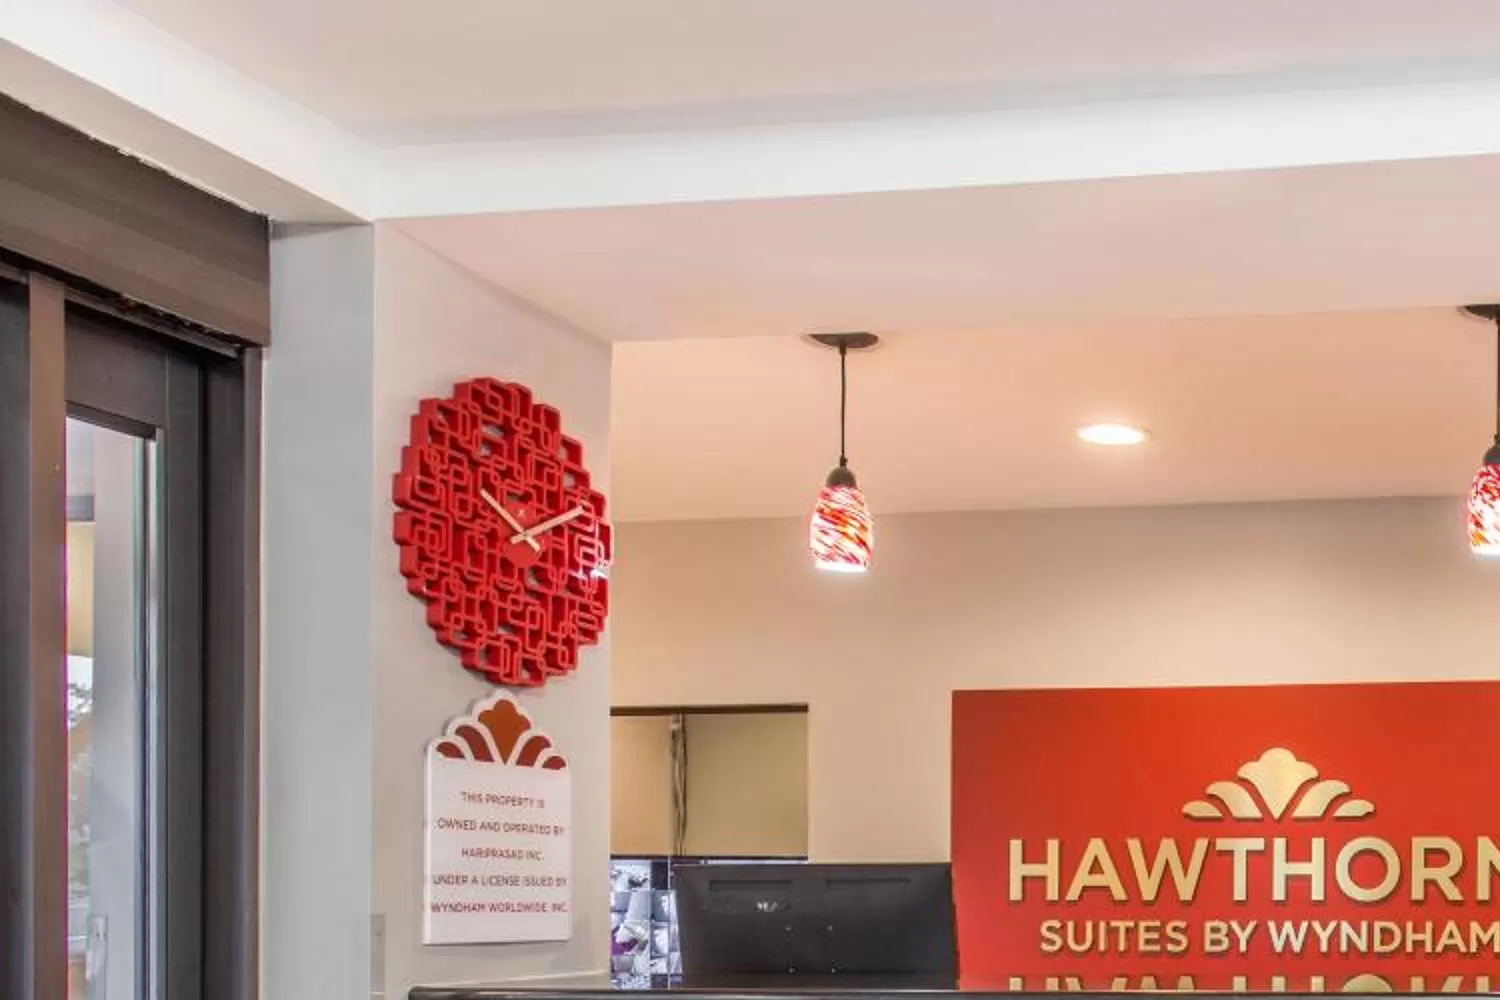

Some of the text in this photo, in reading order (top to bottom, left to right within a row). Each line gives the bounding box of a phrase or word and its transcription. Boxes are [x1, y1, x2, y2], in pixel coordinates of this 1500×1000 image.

[461, 791, 482, 804] THIS
[485, 794, 534, 808] PROPERTY
[437, 817, 564, 836] OWNED AND OPERATED BY
[432, 874, 469, 886] UNDER
[481, 874, 521, 888] LICENSE
[523, 876, 552, 888] ISSUED
[555, 877, 567, 888] BY
[431, 901, 486, 913] WYNDHAM
[488, 901, 547, 913] WORLDWIDE
[1040, 918, 1188, 954] SUITES
[1204, 919, 1257, 954] BY
